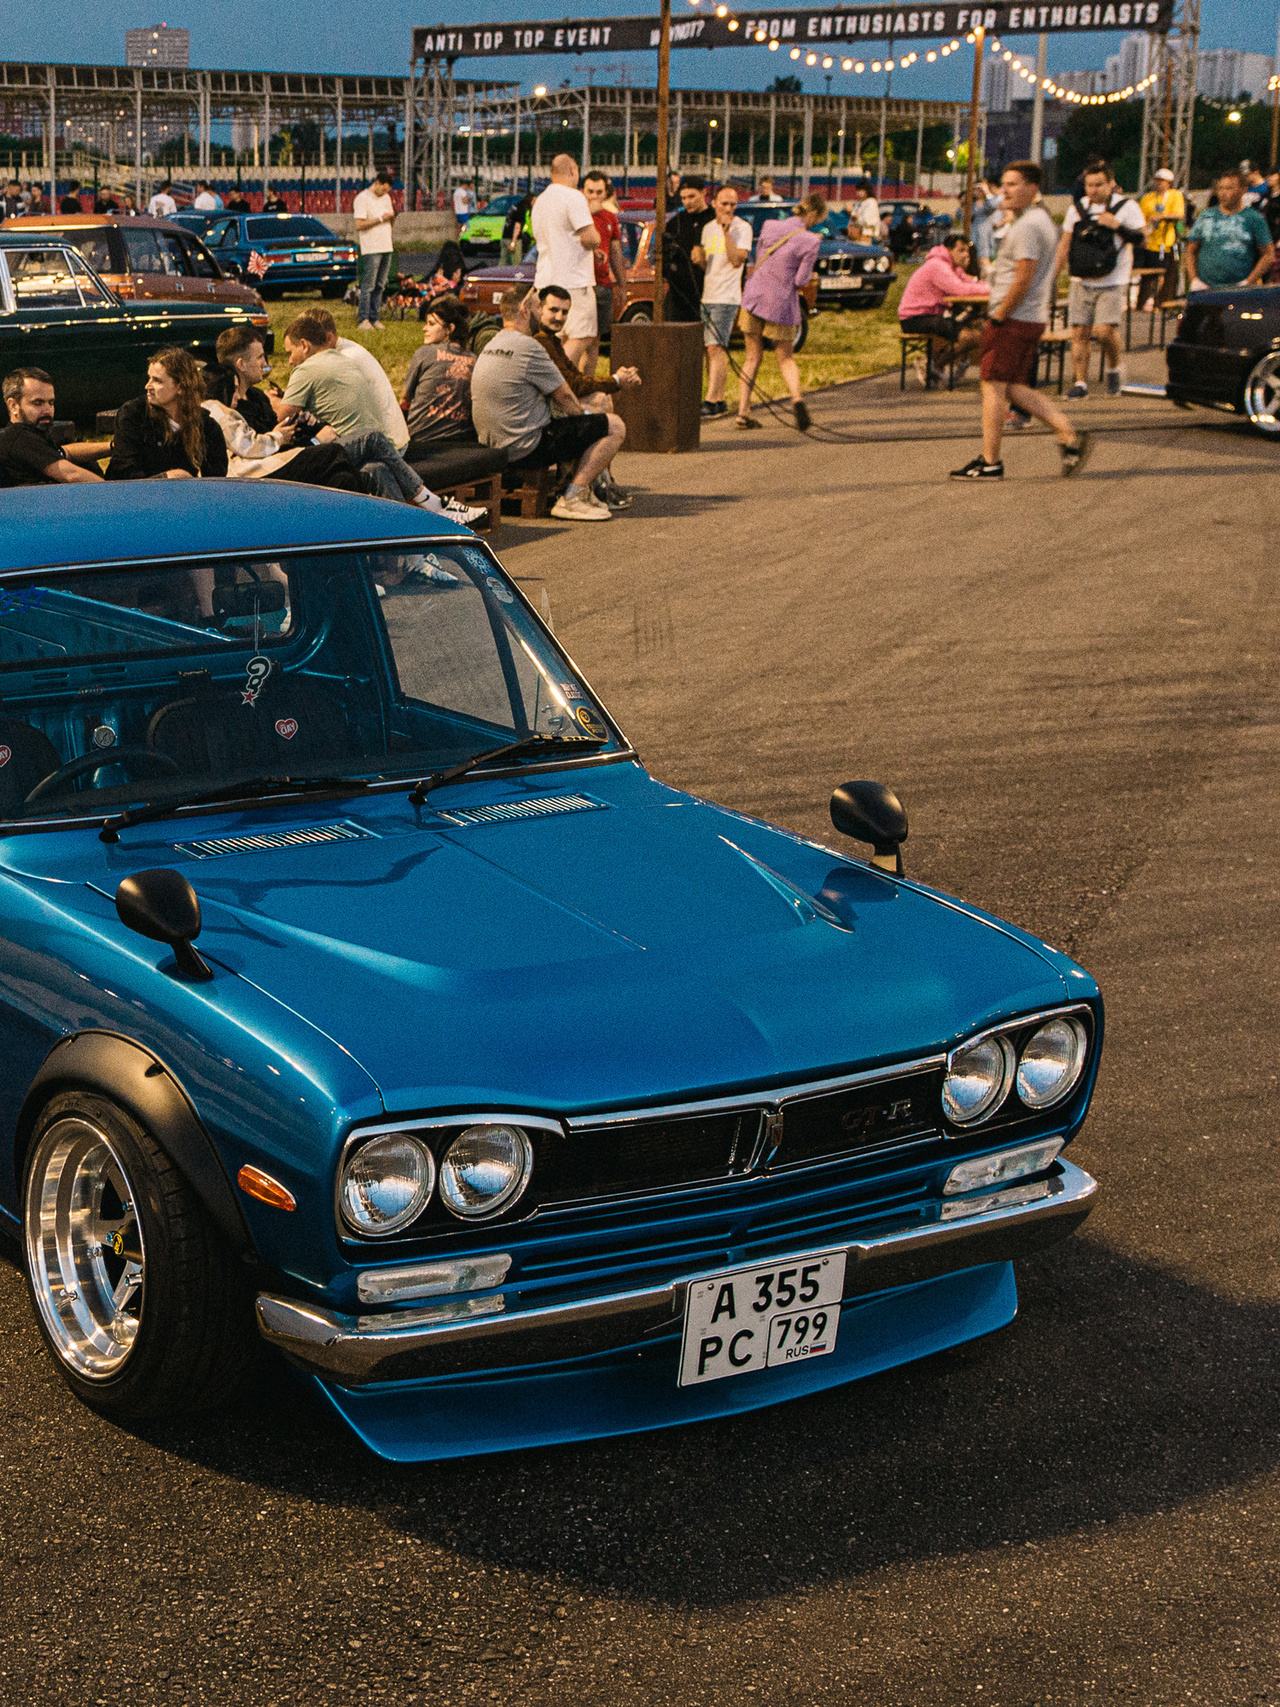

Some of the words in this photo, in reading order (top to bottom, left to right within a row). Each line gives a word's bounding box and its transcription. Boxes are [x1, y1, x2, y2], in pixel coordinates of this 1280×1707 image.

[744, 18, 796, 39] FROM
[807, 10, 946, 37] ENTHUSIASTS
[957, 8, 997, 30] FOR
[1008, 2, 1160, 29] ENTHUSIASTS
[424, 33, 463, 52] ANTI
[473, 31, 504, 50] TOP
[514, 29, 544, 48] TOP
[554, 27, 612, 47] EVENT
[711, 1282, 736, 1324] A
[752, 1264, 821, 1313] 355
[776, 1311, 827, 1349] 799
[697, 1328, 755, 1376] PC
[785, 1344, 809, 1360] RUS
